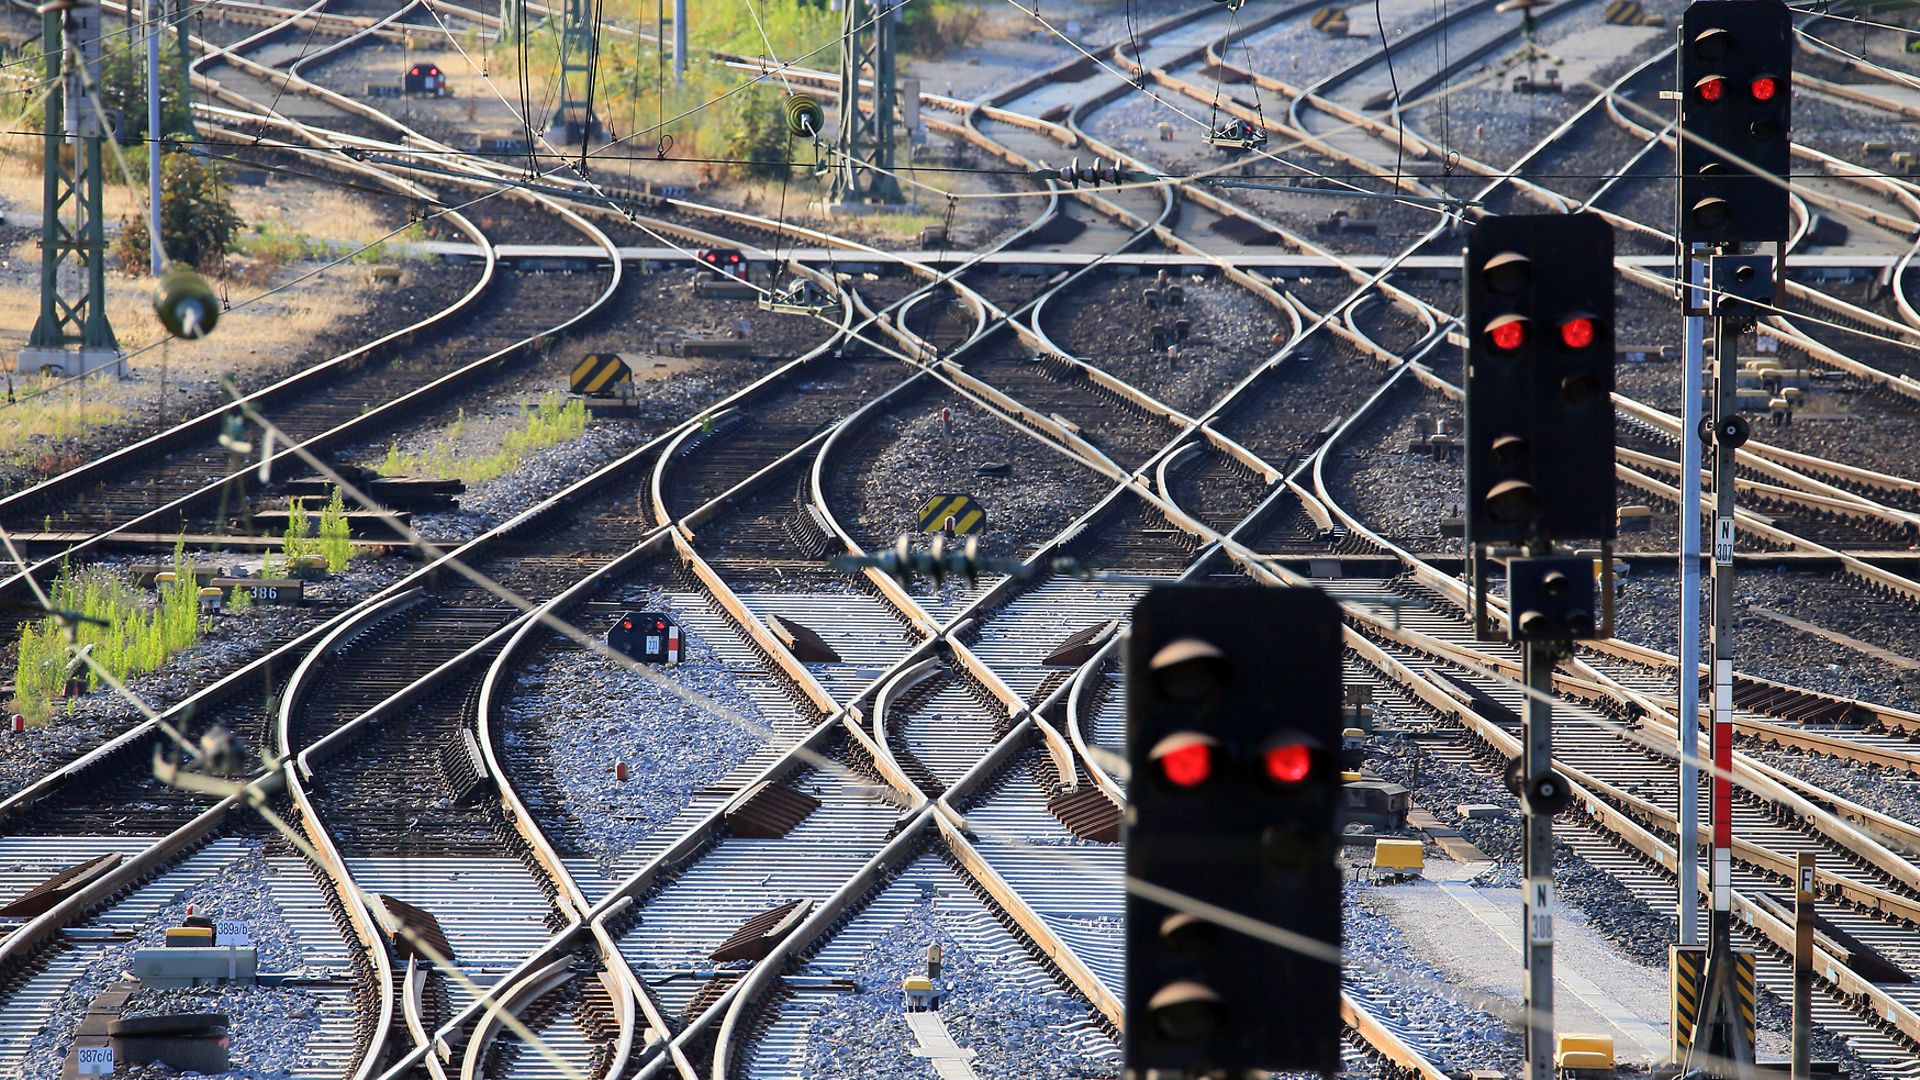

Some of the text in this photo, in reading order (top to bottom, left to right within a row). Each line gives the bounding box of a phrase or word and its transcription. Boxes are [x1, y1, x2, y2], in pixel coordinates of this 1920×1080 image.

[1722, 521, 1730, 539] N
[1717, 543, 1733, 562] 307
[250, 586, 277, 599] 386
[648, 640, 658, 650] 231
[1801, 868, 1811, 890] F
[1537, 884, 1546, 908] N
[218, 922, 247, 935] 389a/b
[1532, 914, 1553, 939] 308
[79, 1049, 112, 1063] 387c/d
